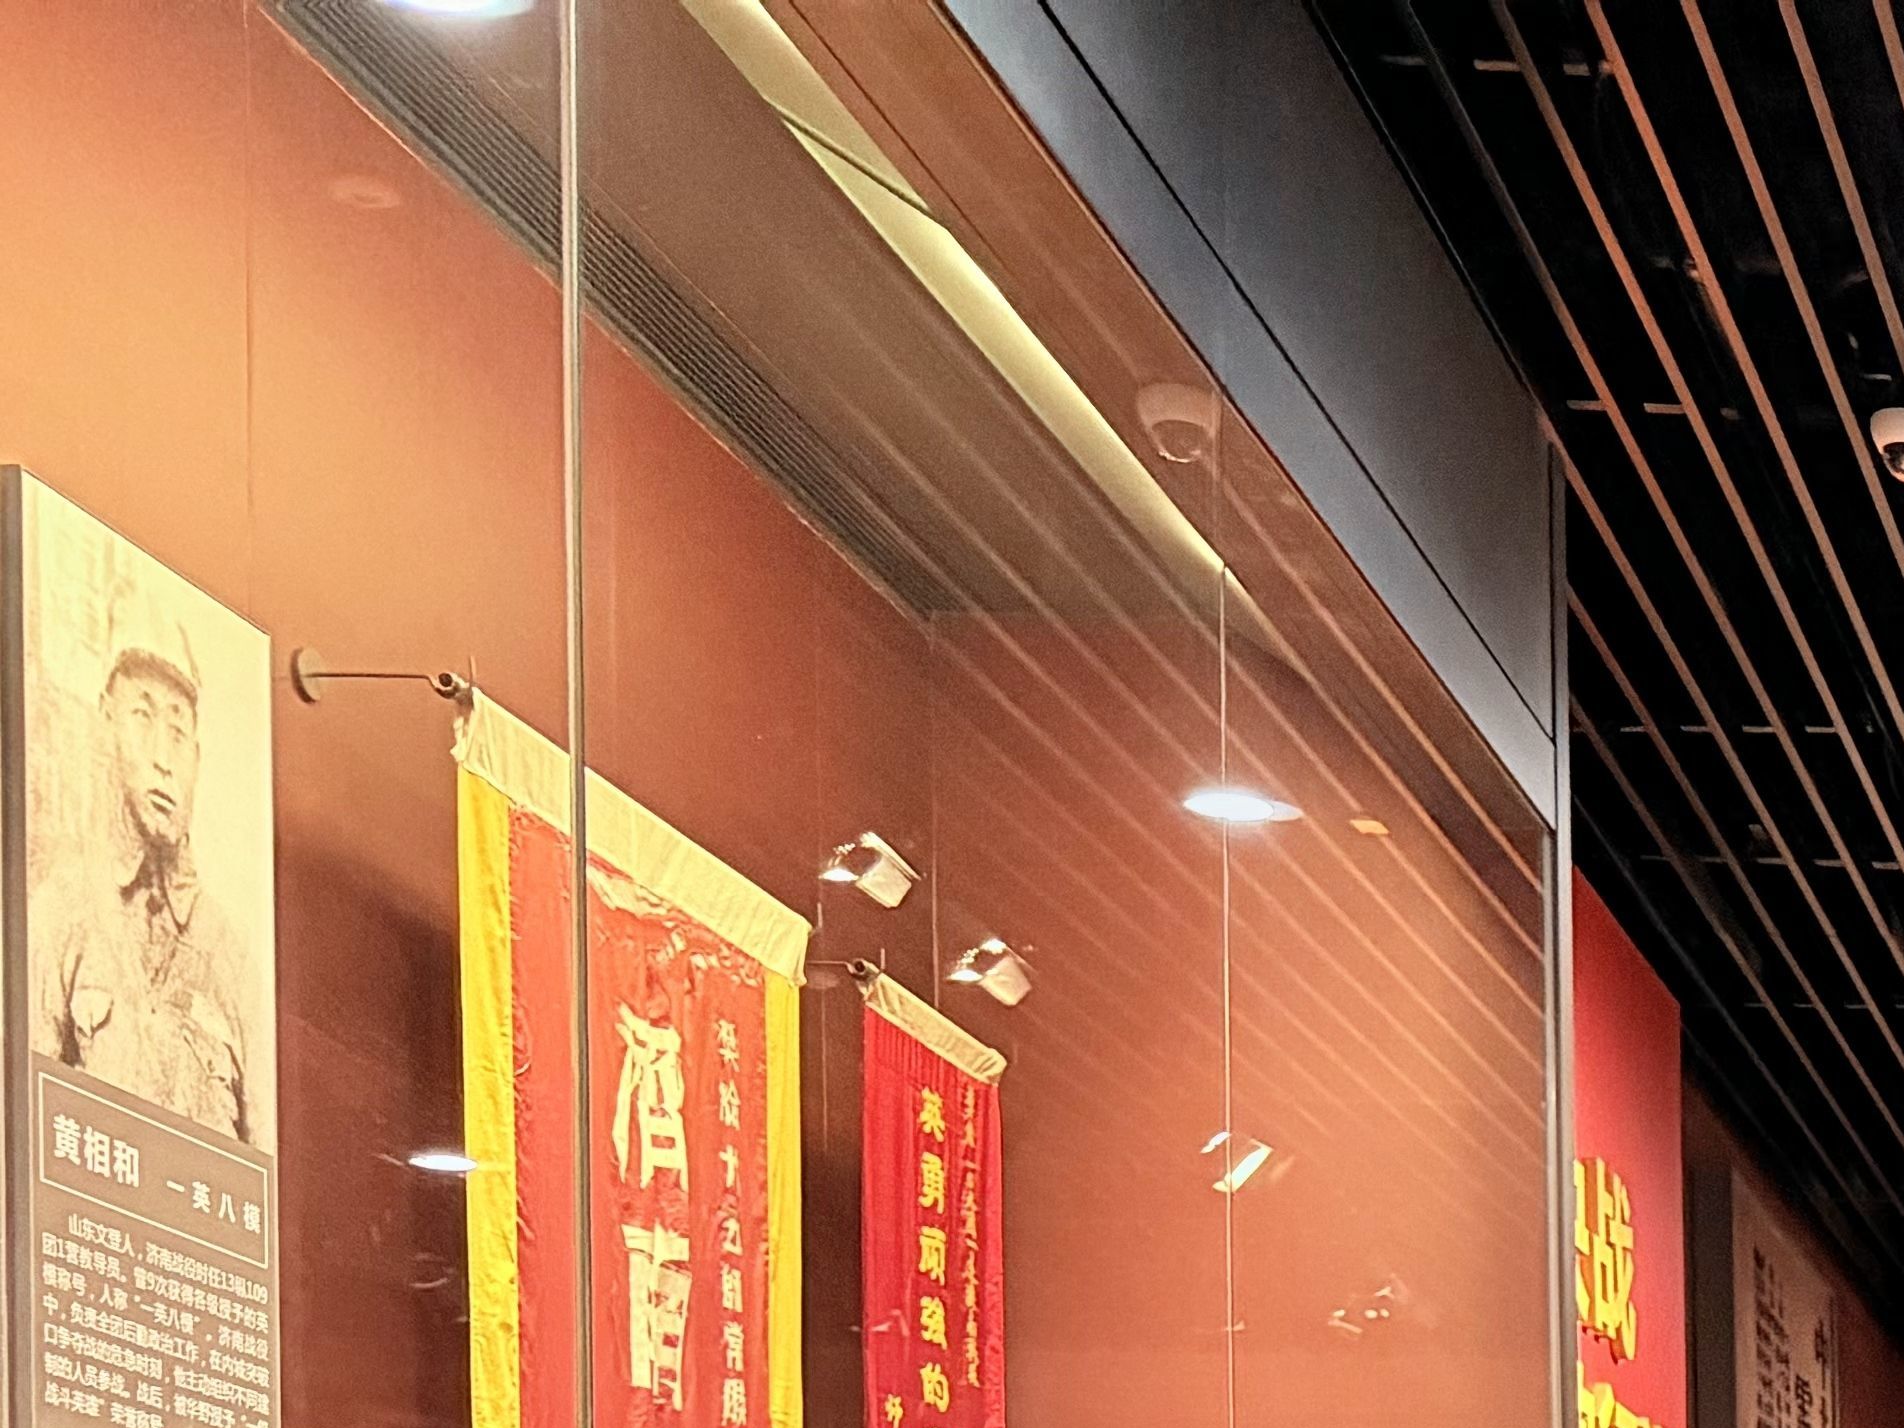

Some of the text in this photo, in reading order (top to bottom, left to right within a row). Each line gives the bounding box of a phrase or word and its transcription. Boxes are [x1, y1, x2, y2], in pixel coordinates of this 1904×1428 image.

[53, 1114, 261, 1234] 黄相和 一英八模
